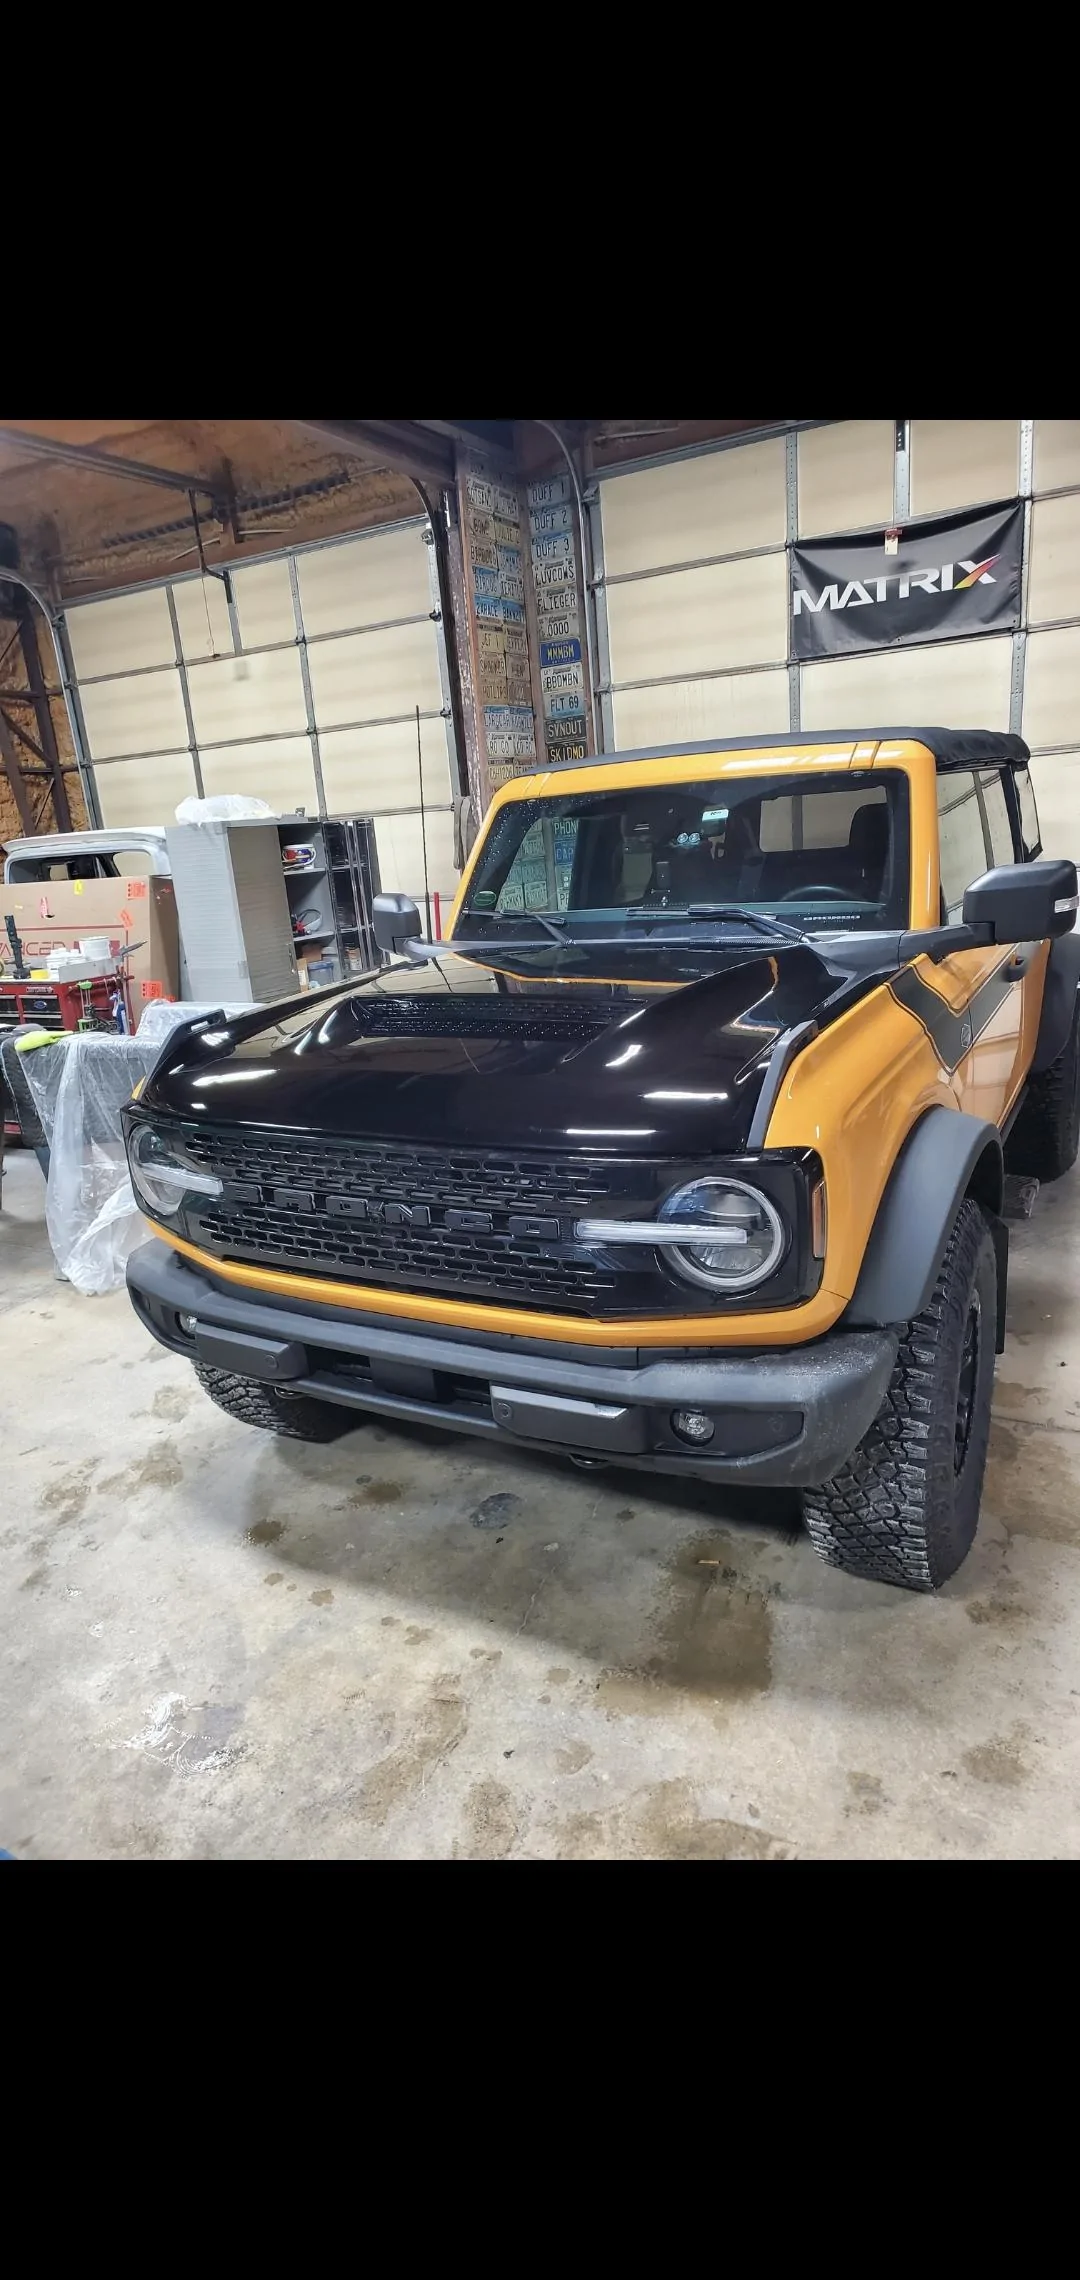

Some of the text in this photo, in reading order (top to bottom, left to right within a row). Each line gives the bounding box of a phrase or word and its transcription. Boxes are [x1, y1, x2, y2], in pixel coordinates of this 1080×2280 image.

[532, 484, 553, 502] DUFF
[534, 509, 568, 531] DUFF 2
[536, 538, 569, 558] DUFF 3
[535, 565, 574, 586] LUVCOWS
[793, 554, 1001, 616] MATRIX
[537, 592, 576, 611] FLIEGER
[550, 695, 579, 713] FLT 69
[548, 719, 582, 738] SVNOUT
[550, 745, 584, 762] SKIDMO
[222, 1181, 561, 1241] BRONCO
